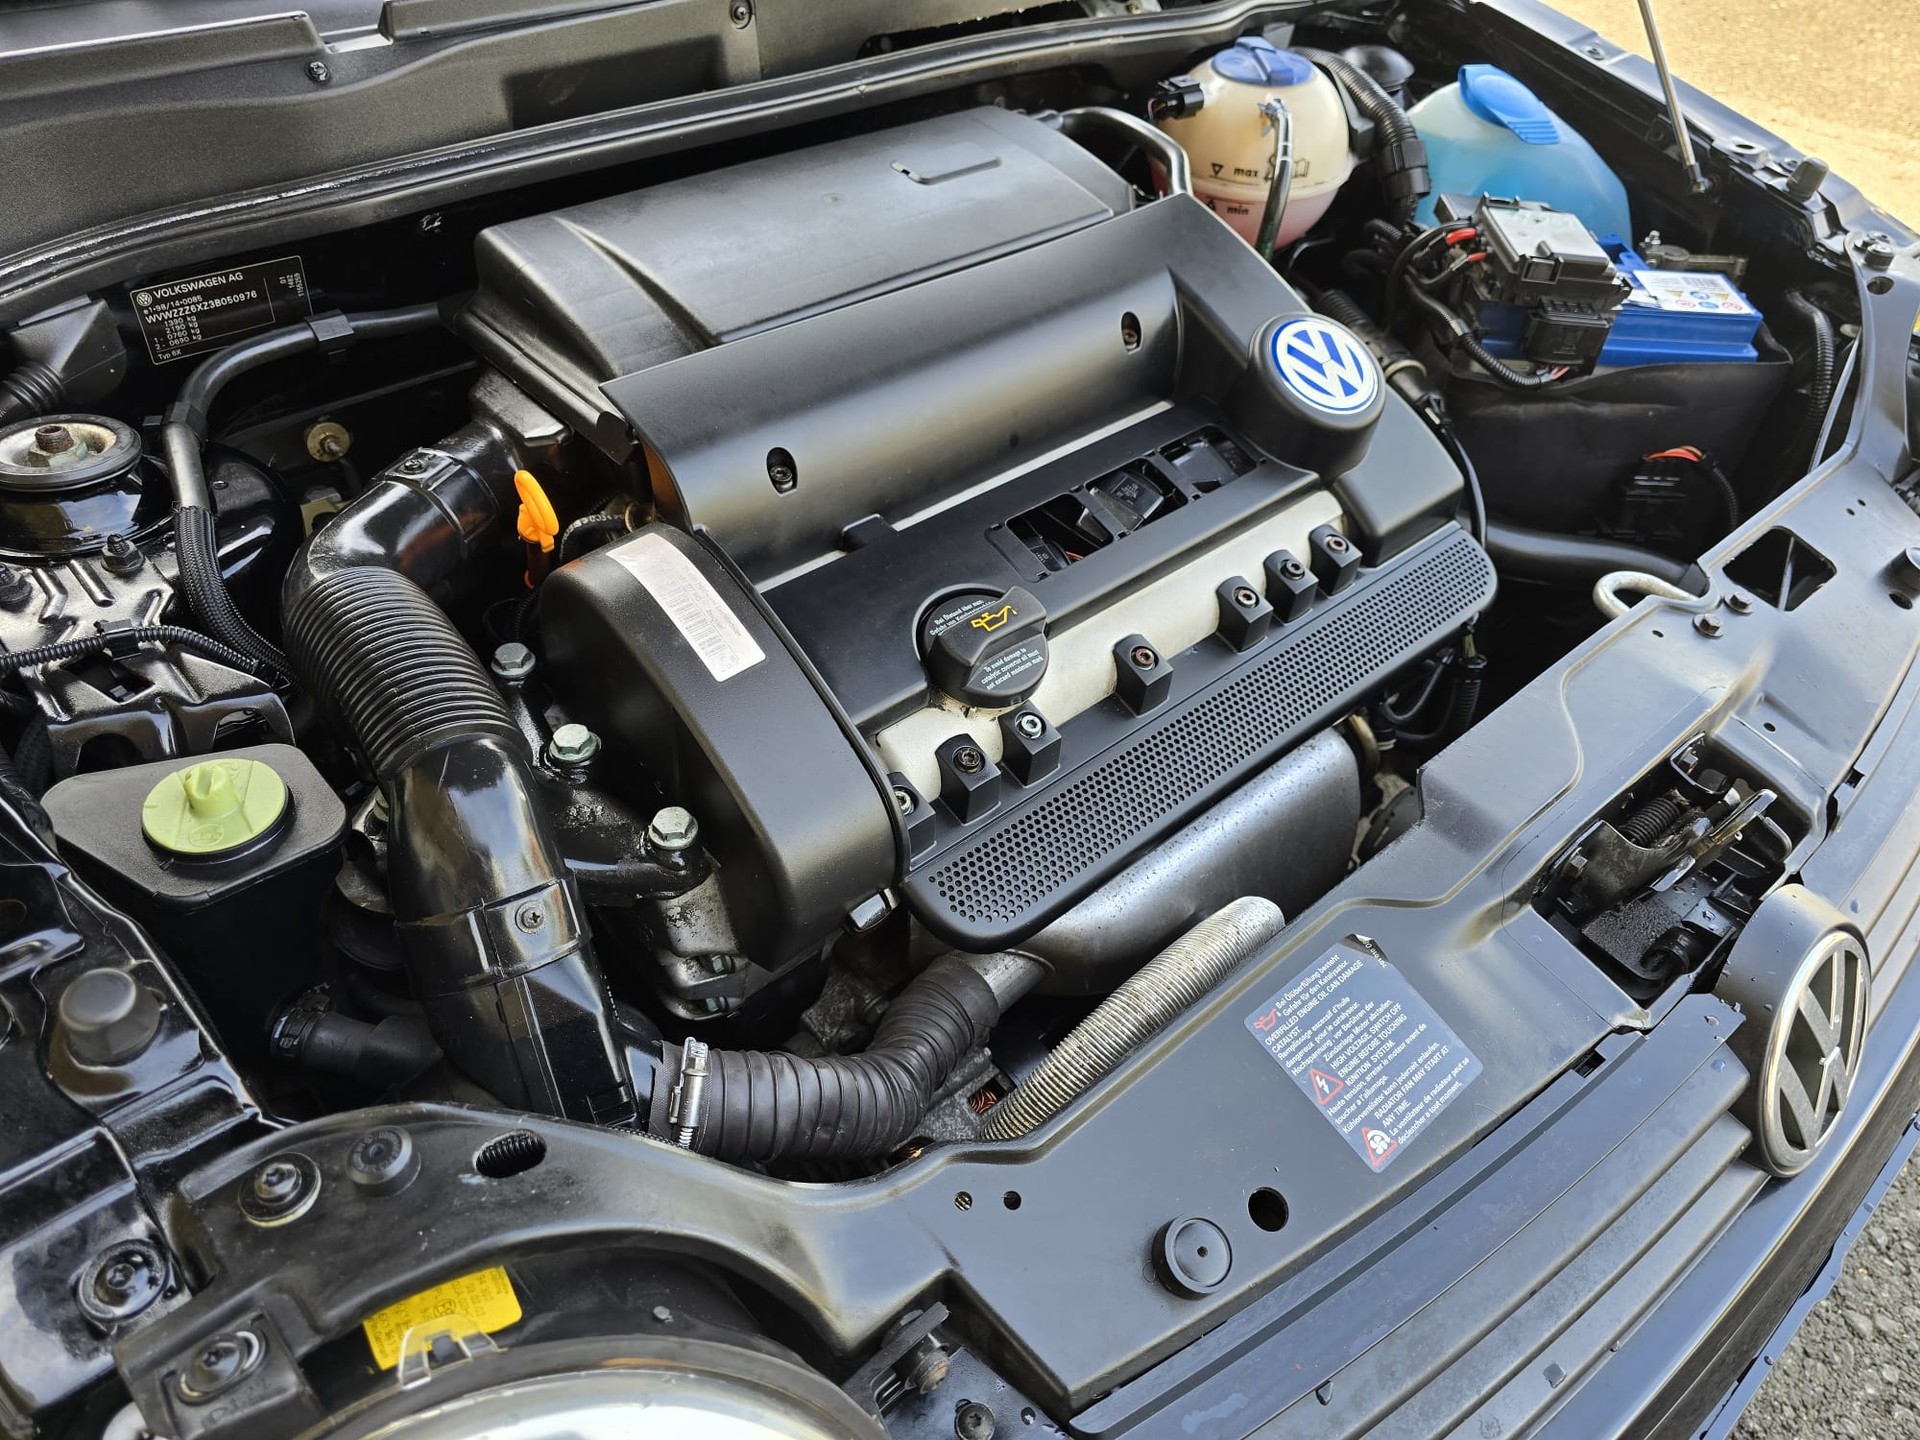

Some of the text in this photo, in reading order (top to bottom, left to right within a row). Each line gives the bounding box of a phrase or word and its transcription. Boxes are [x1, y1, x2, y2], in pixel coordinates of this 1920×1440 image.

[1233, 166, 1259, 178] max
[1227, 203, 1250, 216] min
[154, 272, 243, 298] VOLKSWAGEN AG
[981, 669, 1001, 685] catalytic
[1001, 658, 1022, 673] converter
[1027, 649, 1039, 658] must
[991, 659, 1004, 669] avoid
[1004, 650, 1021, 662] damage
[994, 672, 1011, 685] exceed
[1011, 662, 1032, 676] maximum
[1031, 655, 1043, 664] mark
[1275, 998, 1287, 1009] Bei
[1318, 955, 1340, 973] besteht
[1283, 999, 1302, 1016] Gefahr
[1300, 992, 1310, 1001] für
[1309, 984, 1321, 995] den
[1265, 960, 1363, 1045] OVERFILLED ENGINE OIL CAN DAMAGE
[1341, 1010, 1366, 1031] Berühren
[1365, 1001, 1374, 1011] der
[1278, 1030, 1313, 1060] Remplissage
[1312, 1010, 1333, 1031] excessif
[1286, 1042, 1315, 1068] dangereux
[1315, 1029, 1328, 1044] pour
[1323, 1034, 1354, 1062] Zündanlage
[1352, 1019, 1370, 1035] Motor
[1330, 1054, 1347, 1070] HIGH
[1369, 1012, 1392, 1034] SWITCH
[1390, 1003, 1401, 1015] OFF
[1338, 1014, 1407, 1078] ENGINE BEFORE TOUCHING
[1327, 1099, 1346, 1116] Haute
[1388, 1042, 1406, 1061] moteur
[1405, 1029, 1420, 1044] avant
[1345, 1061, 1372, 1086] IGNITION
[1374, 1090, 1404, 1119] RADIATOR
[1401, 1080, 1415, 1093] FAN
[1412, 1068, 1426, 1083] MAY
[1424, 1052, 1442, 1071] START
[1335, 1103, 1357, 1125] toucher
[1342, 1094, 1384, 1134] Kühlerventilator
[1382, 1082, 1398, 1096] kann
[1395, 1061, 1419, 1085] jederzeit
[1397, 1102, 1424, 1129] ventilateur
[1430, 1074, 1452, 1097] radiateur
[1451, 1063, 1464, 1077] peut
[1429, 1101, 1441, 1113] tout
[1382, 1112, 1395, 1128] ANY
